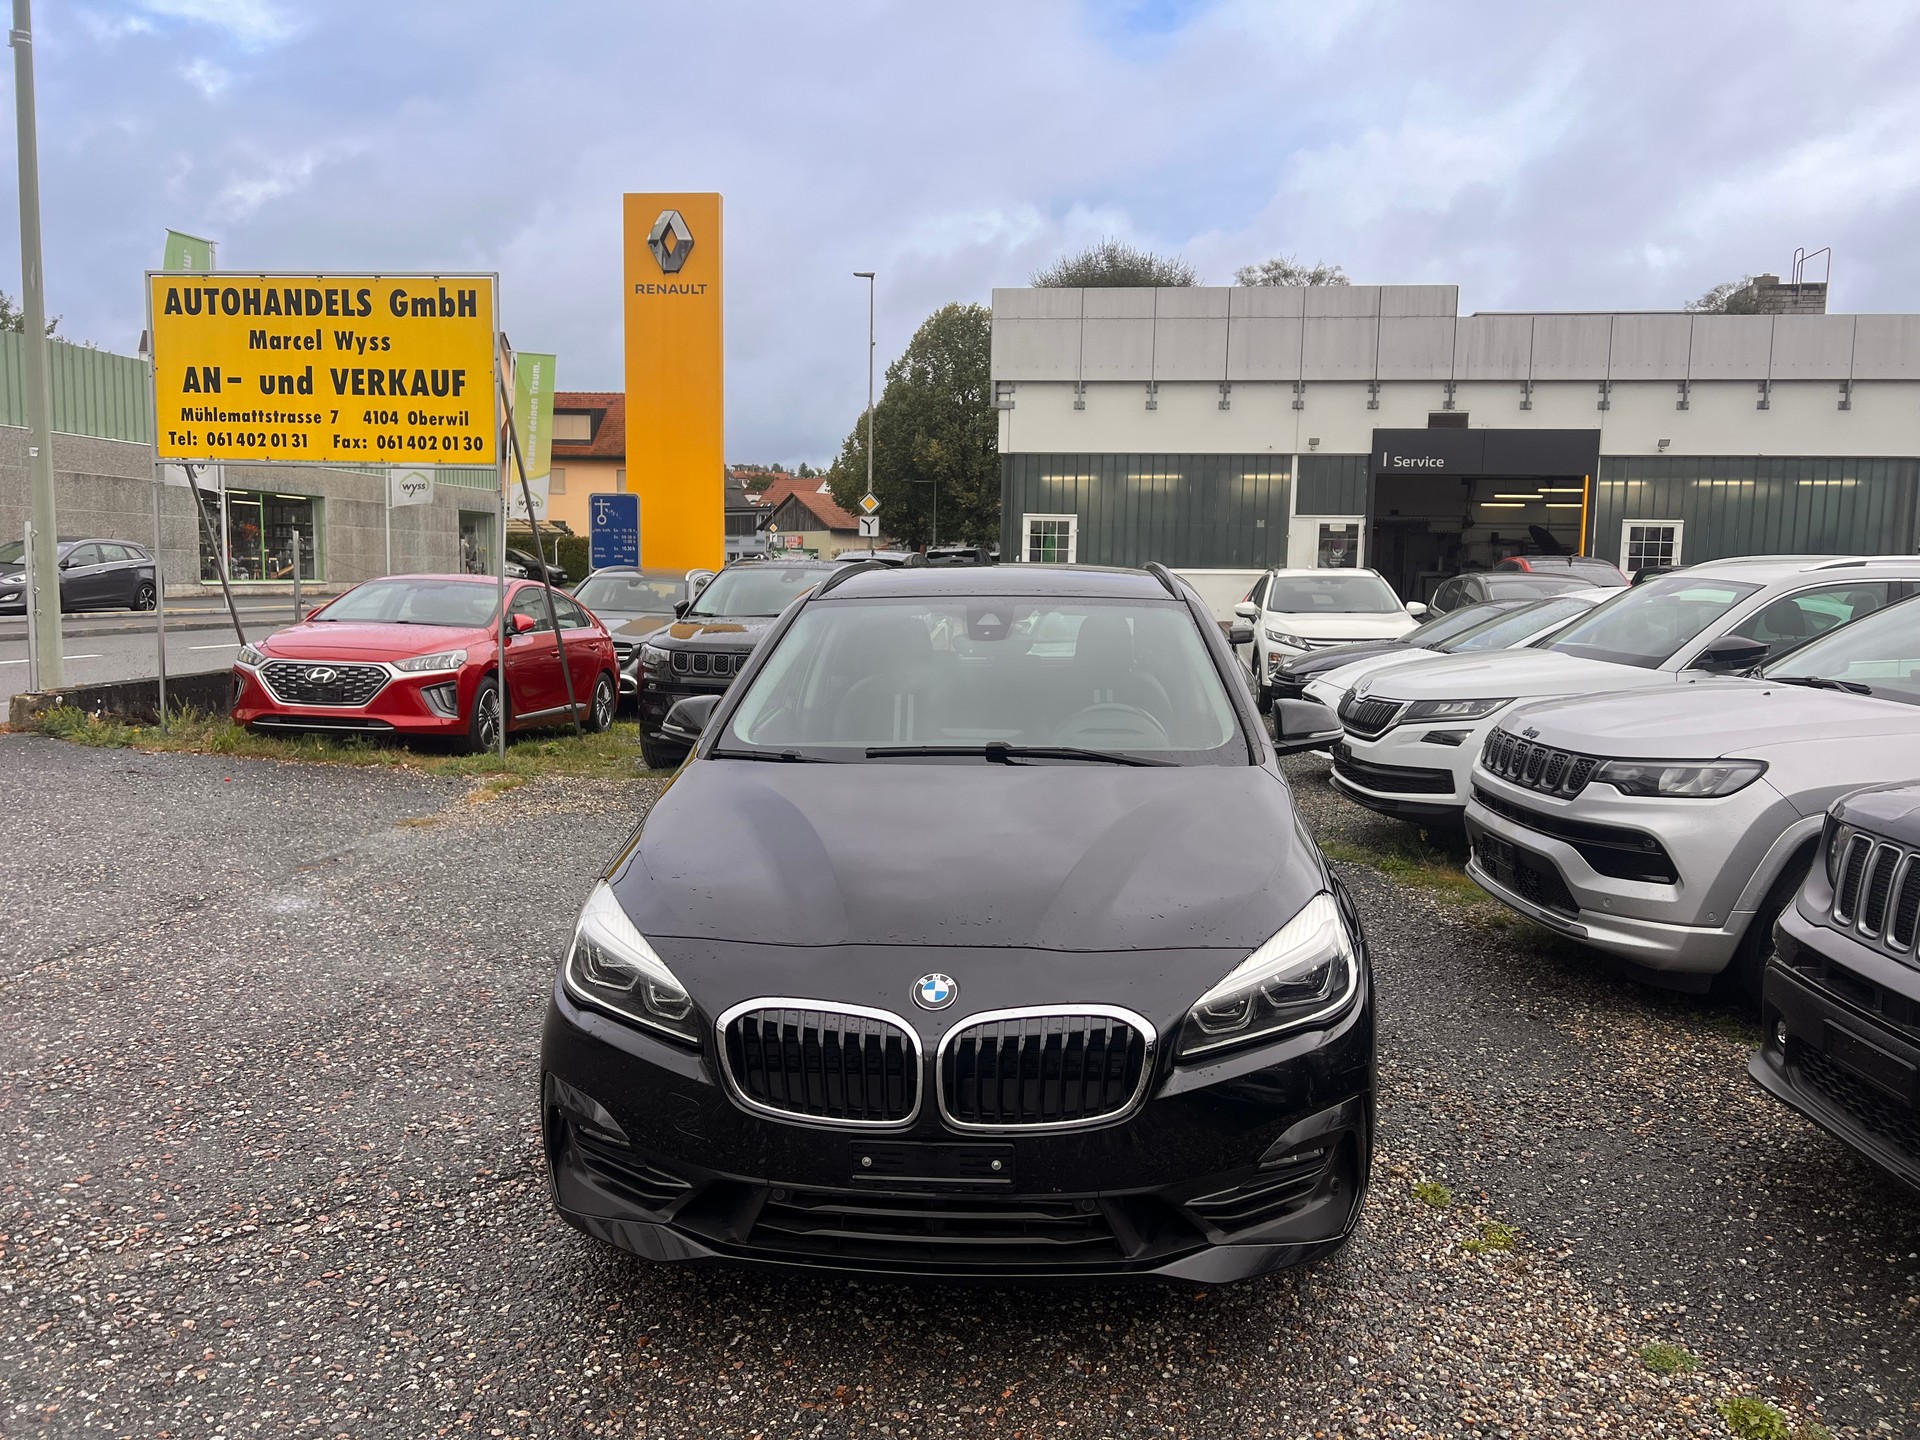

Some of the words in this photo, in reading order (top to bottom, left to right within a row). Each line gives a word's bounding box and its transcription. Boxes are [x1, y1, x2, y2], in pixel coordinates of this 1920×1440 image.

[635, 284, 707, 294] RENAULT
[164, 287, 372, 317] AUTOHANDELS
[389, 287, 477, 318] GmbH
[249, 328, 322, 351] Marcel
[333, 330, 391, 356] Wyss
[259, 365, 314, 396] und
[329, 368, 467, 397] VERKAUF
[529, 361, 541, 395] Traum.
[181, 407, 323, 425] Mühlemattstrasse
[330, 410, 339, 424] 7
[362, 410, 399, 425] 4104
[407, 411, 469, 427] Oberwil
[528, 397, 539, 431] deinen
[168, 431, 198, 446] Tel:
[333, 434, 368, 449] Fax:
[1393, 456, 1445, 468] Service
[918, 974, 954, 986] BMW
